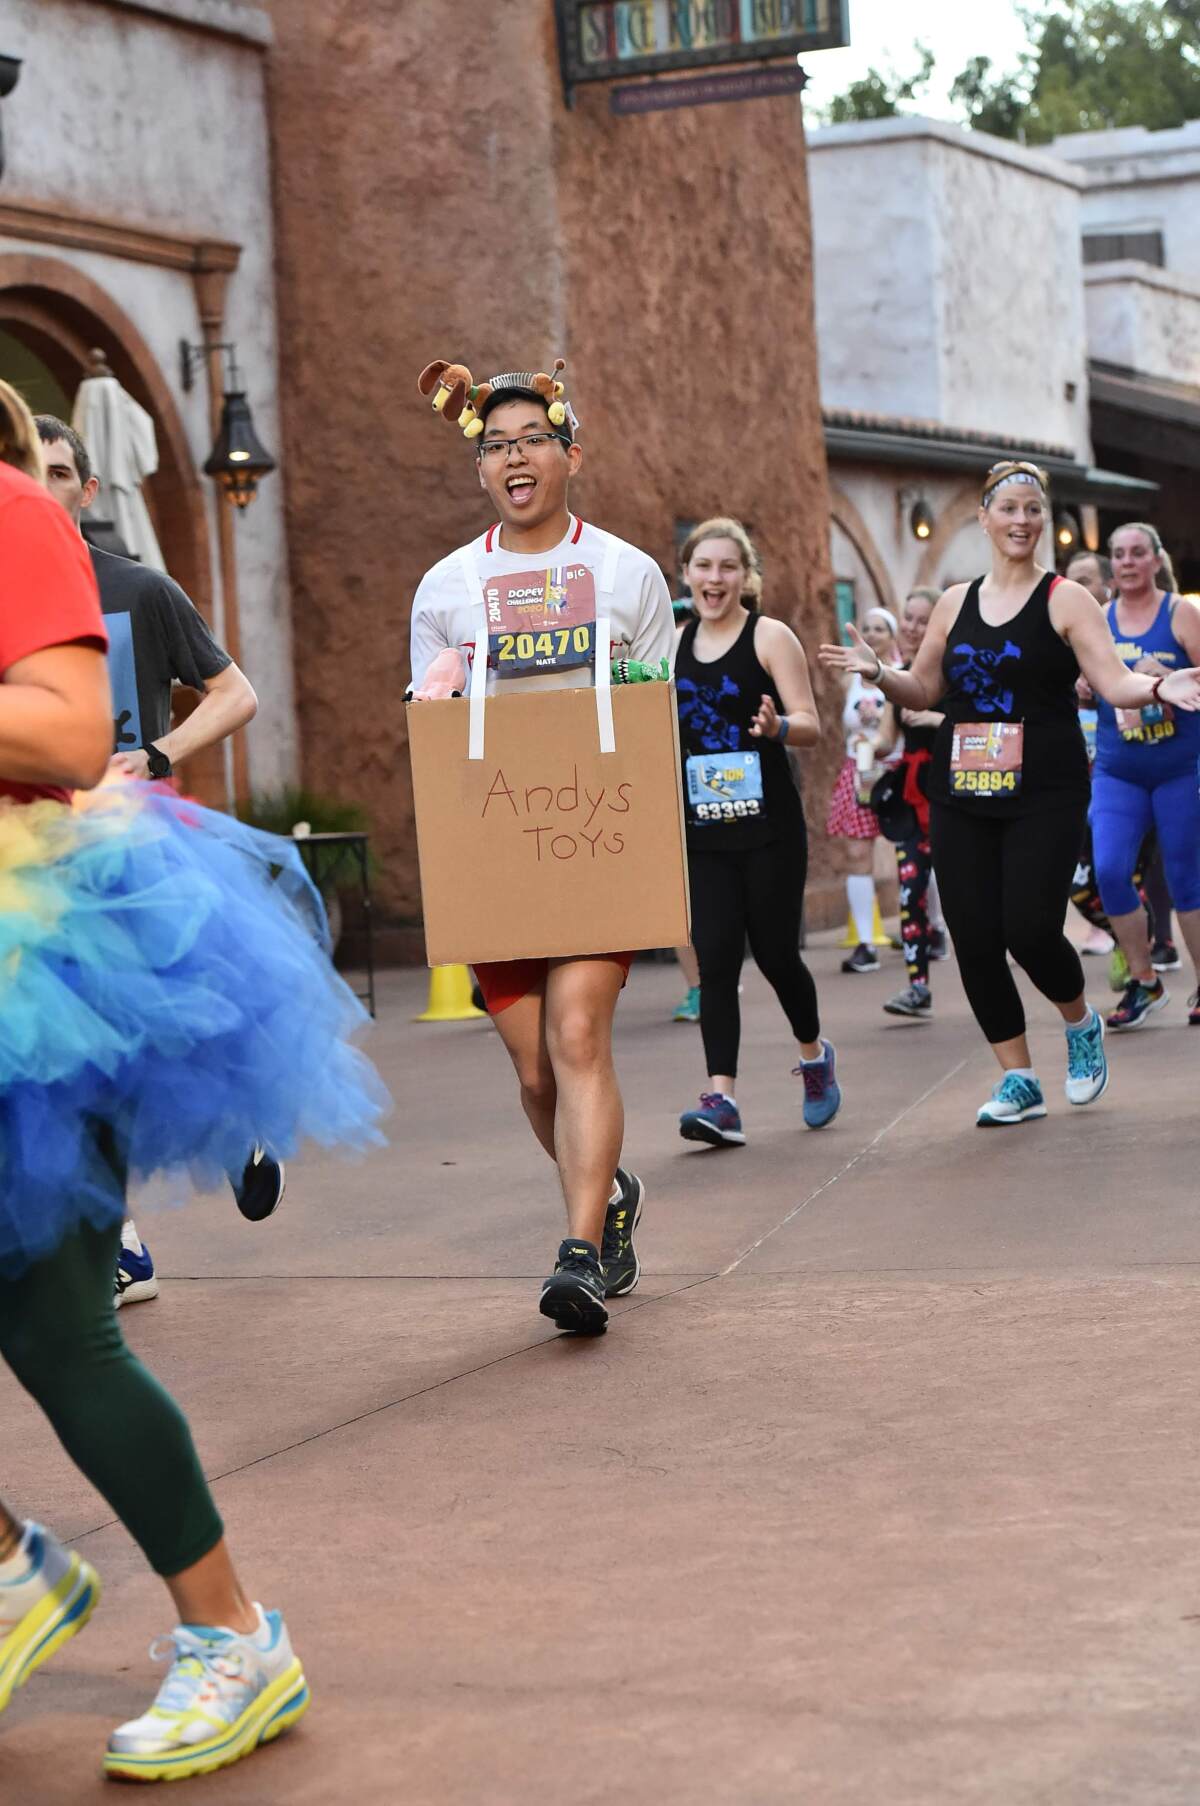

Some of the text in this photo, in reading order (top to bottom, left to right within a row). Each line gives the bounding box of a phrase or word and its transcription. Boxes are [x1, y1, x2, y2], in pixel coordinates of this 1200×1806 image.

[506, 597, 544, 607] CHALLENGE
[508, 587, 544, 599] DOPEY
[487, 588, 501, 622] 20470
[498, 626, 590, 661] 20470
[535, 657, 557, 667] NATE
[953, 770, 1016, 791] 25894
[481, 763, 633, 828] Andys
